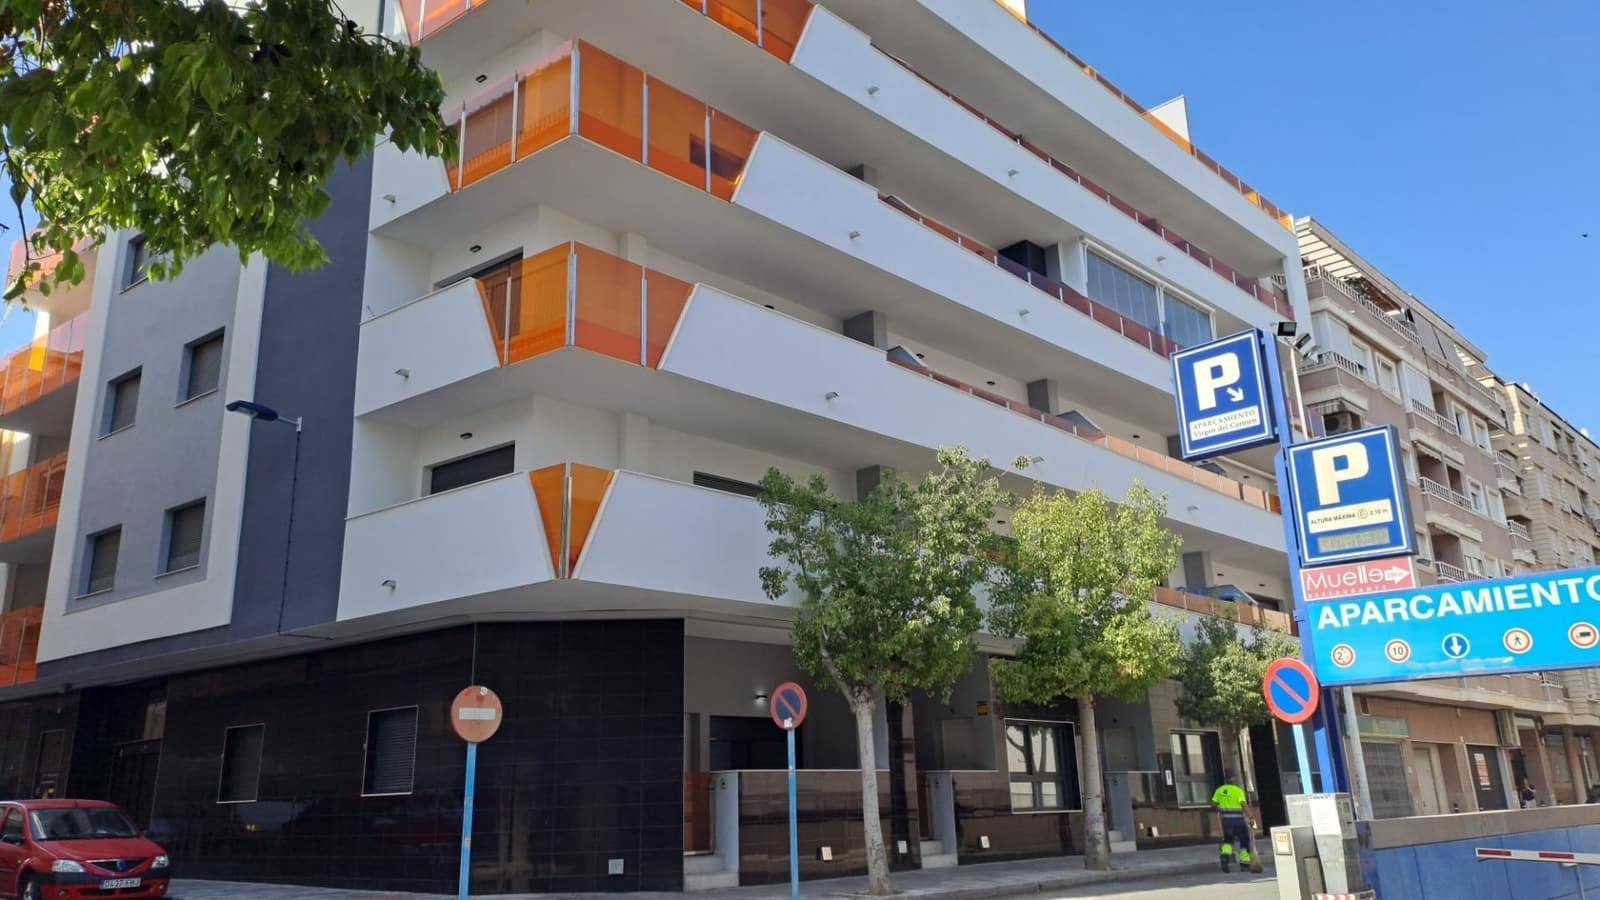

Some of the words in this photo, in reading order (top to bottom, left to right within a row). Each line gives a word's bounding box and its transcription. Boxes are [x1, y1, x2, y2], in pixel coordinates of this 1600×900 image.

[1193, 352, 1240, 411] P
[1193, 409, 1256, 429] APARCAMIENTO
[1218, 423, 1228, 432] del
[1312, 442, 1369, 506] P
[1310, 516, 1332, 524] ALTURA
[1306, 565, 1383, 591] Muelle
[1392, 646, 1404, 656] 10
